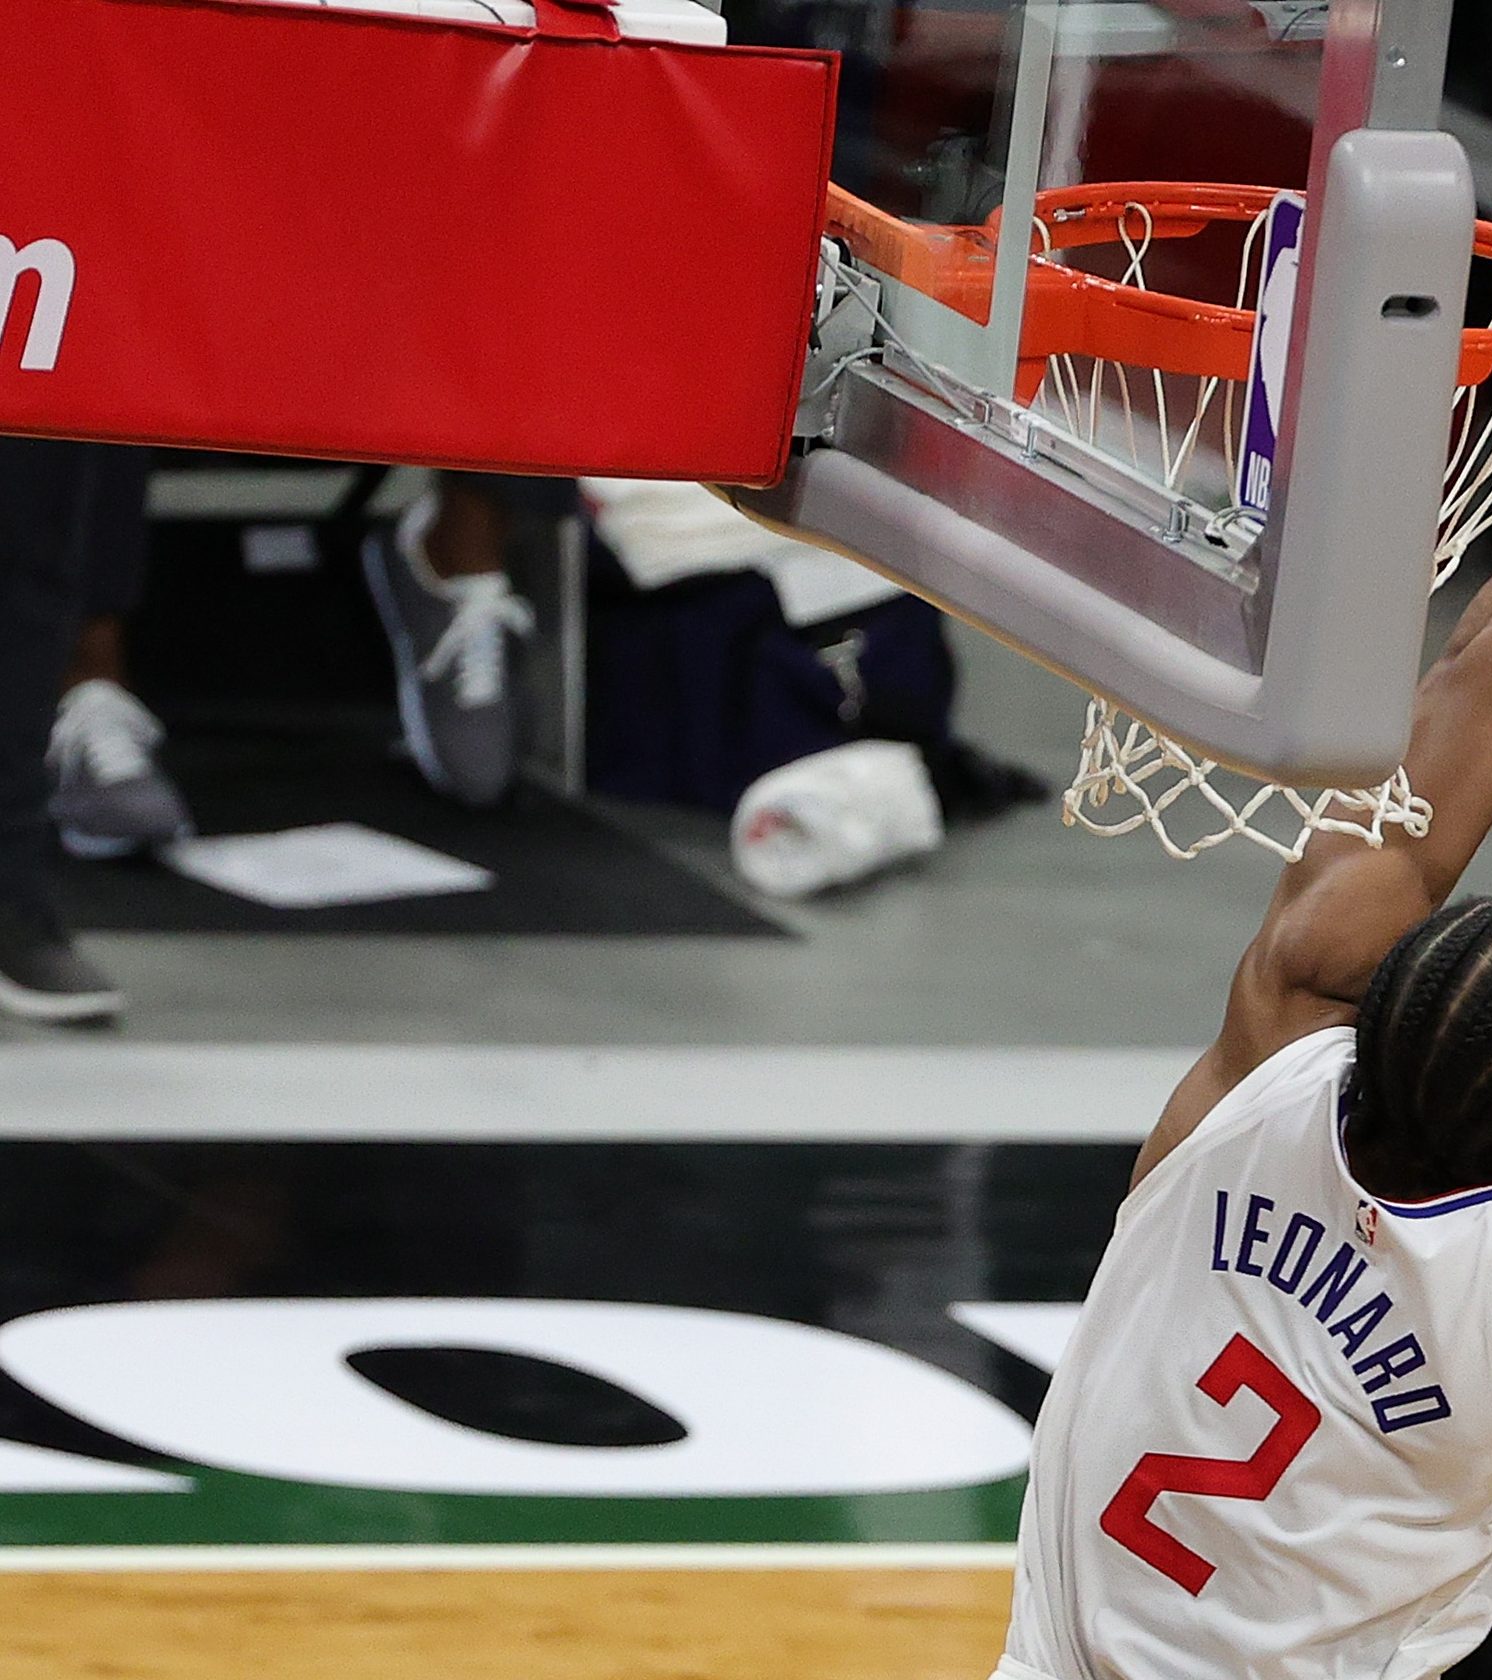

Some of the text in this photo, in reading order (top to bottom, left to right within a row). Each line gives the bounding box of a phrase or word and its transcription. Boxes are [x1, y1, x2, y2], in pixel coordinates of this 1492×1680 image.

[1245, 451, 1272, 511] NB
[1211, 1190, 1452, 1434] LEONARD
[1099, 1332, 1322, 1597] 2
